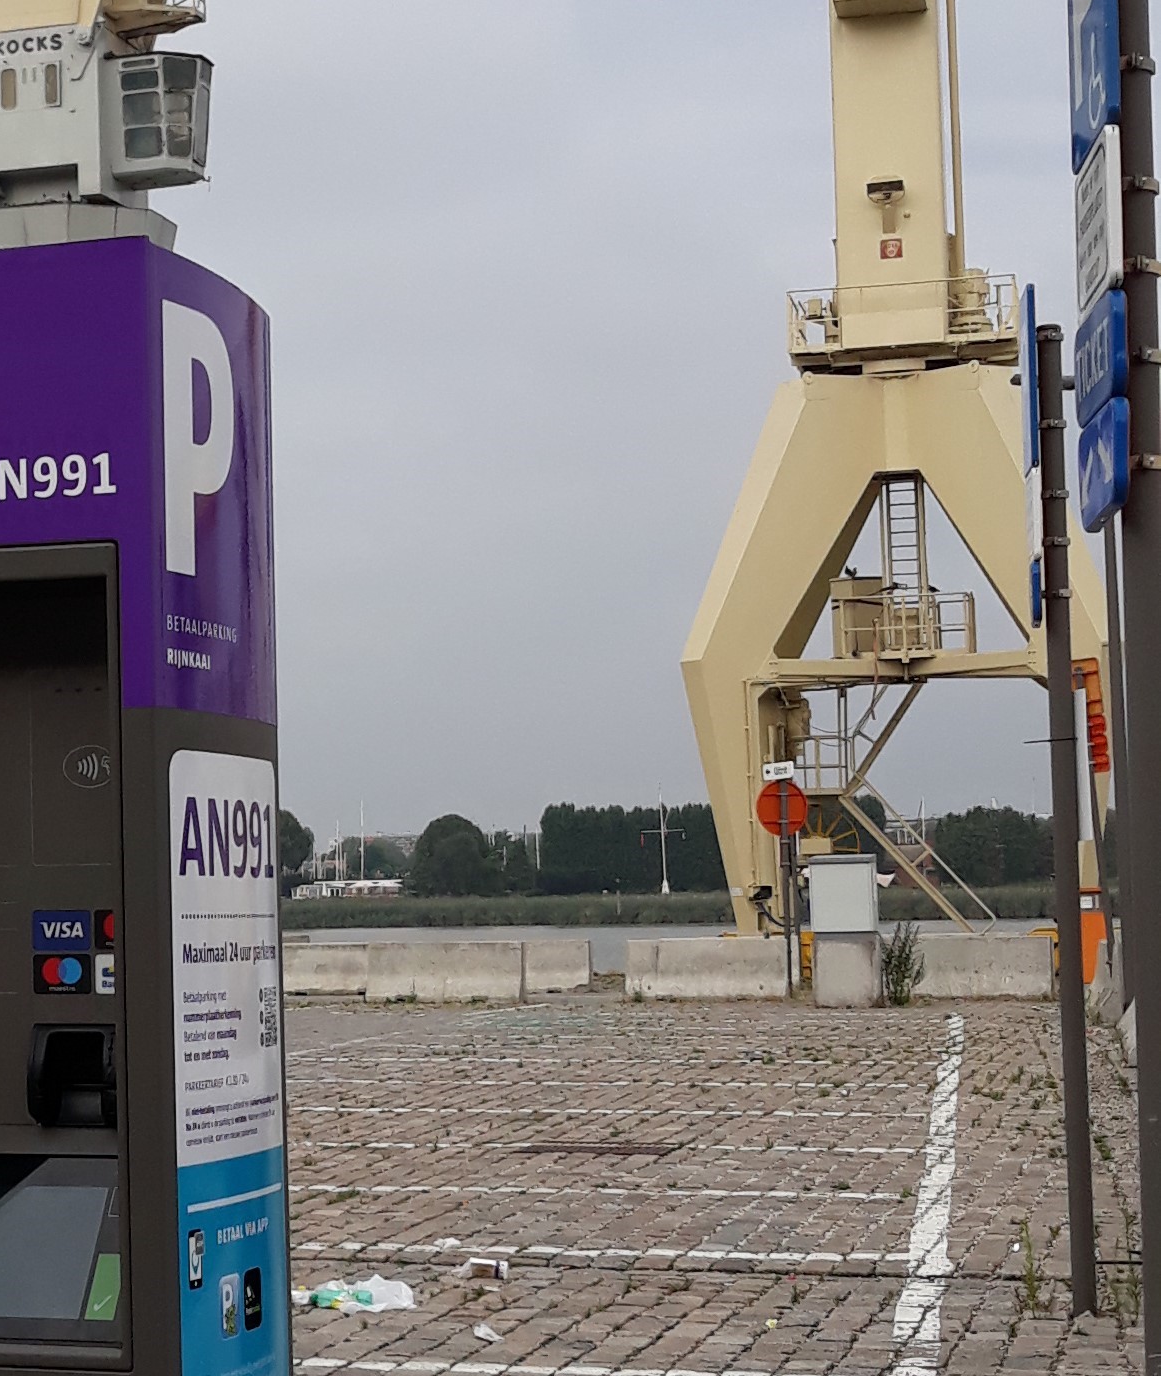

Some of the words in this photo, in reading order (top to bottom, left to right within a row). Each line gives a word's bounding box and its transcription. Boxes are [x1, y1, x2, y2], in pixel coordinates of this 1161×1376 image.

[1075, 316, 1110, 402] TICKET
[162, 299, 235, 577] P
[166, 613, 238, 644] BETAALPARKING
[166, 647, 212, 671] RIJNKAAI
[178, 796, 274, 879] AN991
[39, 921, 84, 939] VISA
[182, 941, 228, 964] Maximaal
[229, 942, 238, 962] 24
[217, 1224, 244, 1246] BETAAL
[245, 1220, 257, 1237] VIA
